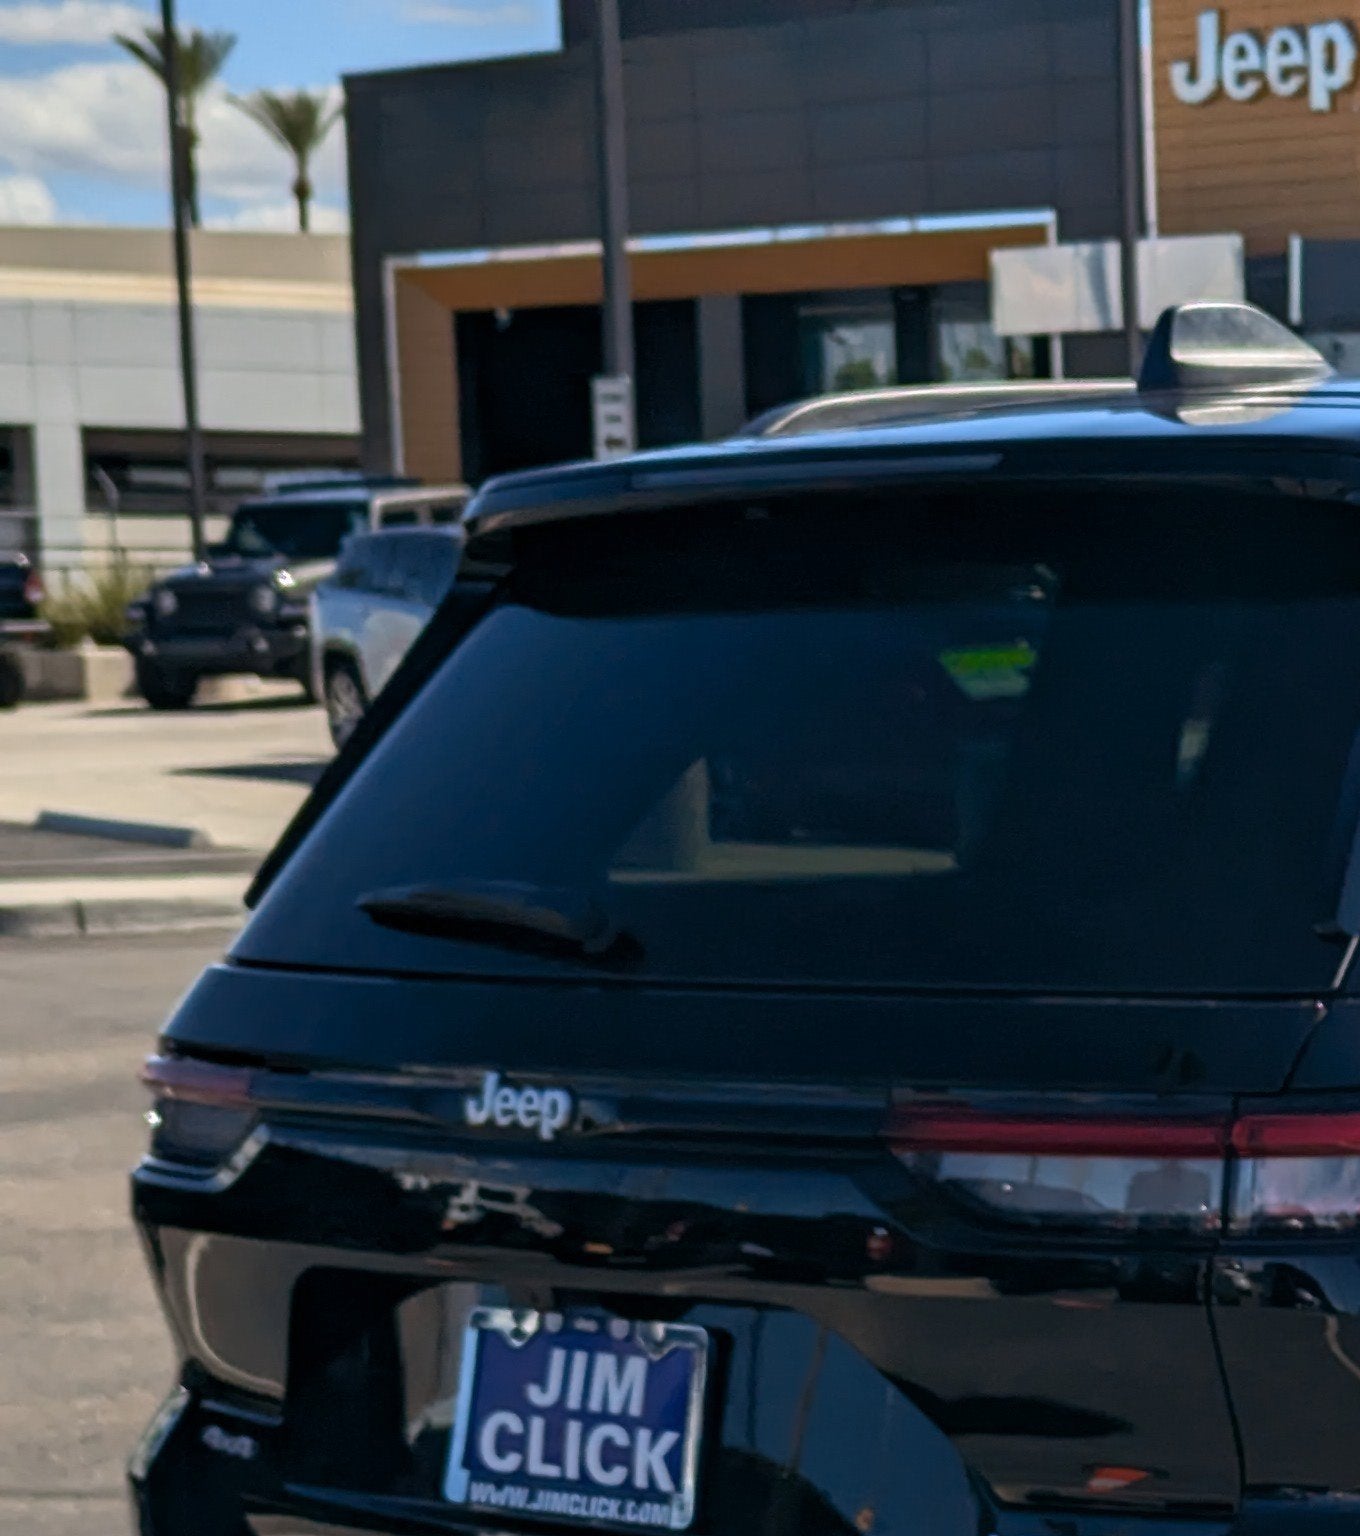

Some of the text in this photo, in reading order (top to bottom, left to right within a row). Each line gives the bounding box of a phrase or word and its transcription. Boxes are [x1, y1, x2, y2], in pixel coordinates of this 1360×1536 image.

[1168, 9, 1358, 113] Jeep
[465, 1071, 572, 1140] Jeep
[525, 1347, 649, 1418] JIM
[479, 1410, 681, 1493] CLICK
